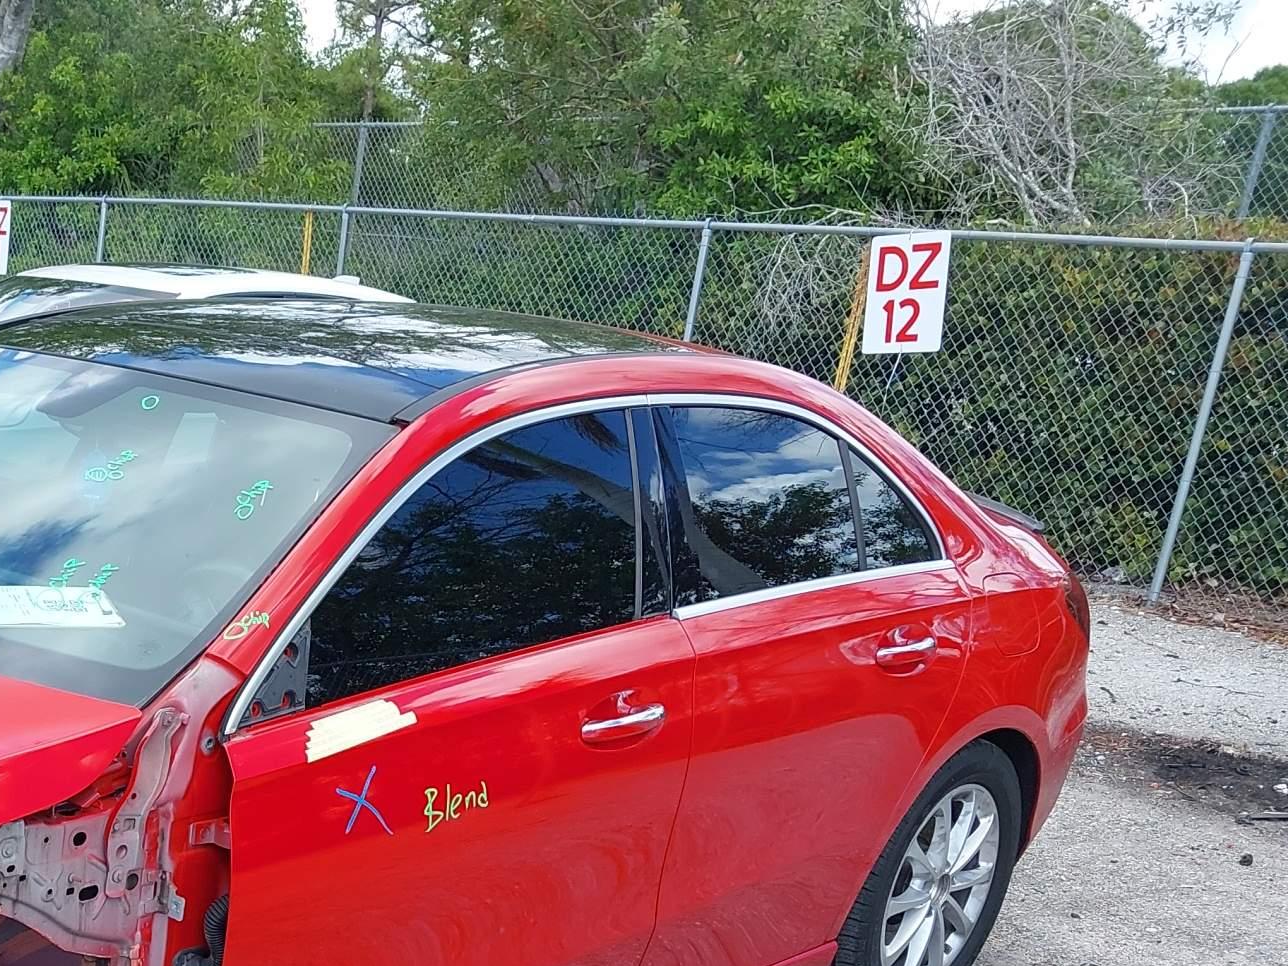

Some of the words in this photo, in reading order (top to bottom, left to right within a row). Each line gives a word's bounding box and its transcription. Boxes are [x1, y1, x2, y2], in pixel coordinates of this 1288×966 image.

[875, 242, 942, 292] DZ
[882, 298, 920, 343] 12
[424, 781, 489, 832] Blend
